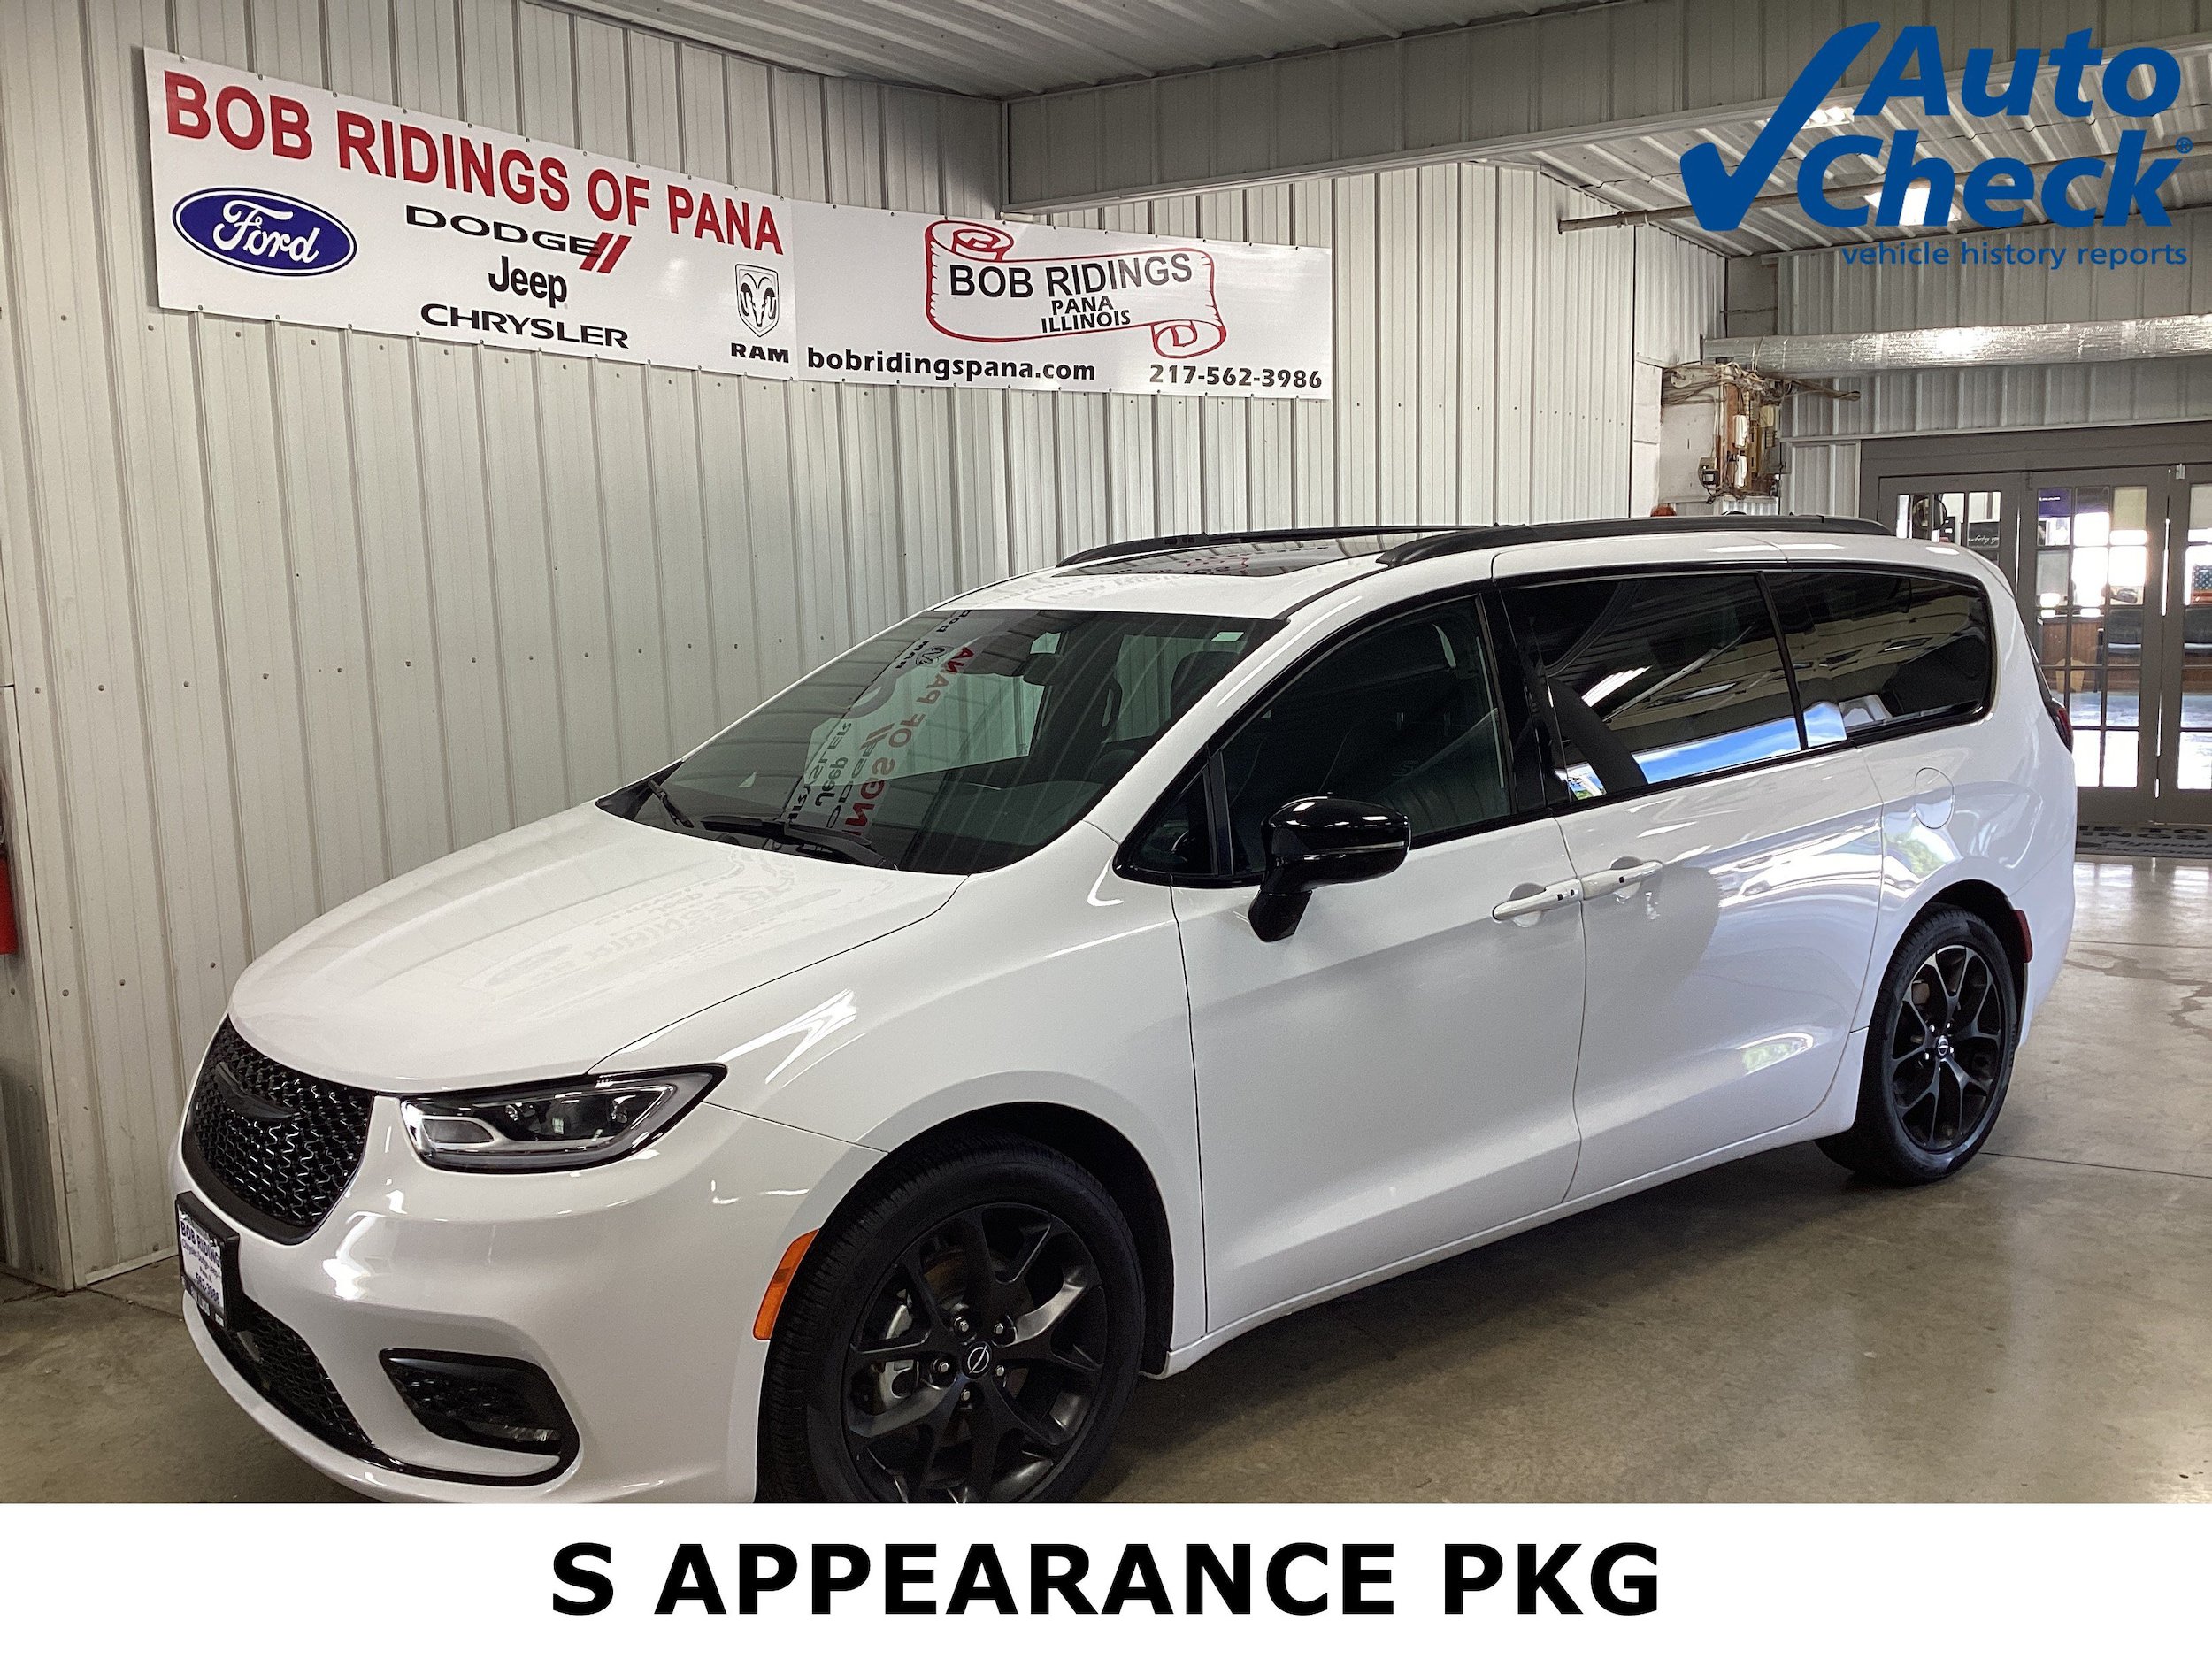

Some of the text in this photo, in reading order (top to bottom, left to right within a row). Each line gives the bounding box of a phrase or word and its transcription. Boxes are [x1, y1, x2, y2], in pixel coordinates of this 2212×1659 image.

[165, 70, 783, 255] BOB RIDINGS OF PANA
[212, 199, 321, 264] Ford
[406, 204, 602, 258] DODGE
[488, 255, 567, 309] Jeep
[949, 252, 1193, 298] BOB RIDINGS
[420, 303, 629, 349] CHRYSLER
[1041, 310, 1132, 334] ILLINOIS
[1050, 295, 1116, 316] PANA
[732, 342, 789, 364] RAM
[807, 346, 1096, 382] bobridingspana.com
[1149, 364, 1323, 388] 217-562-3986
[180, 1220, 196, 1246] BOB
